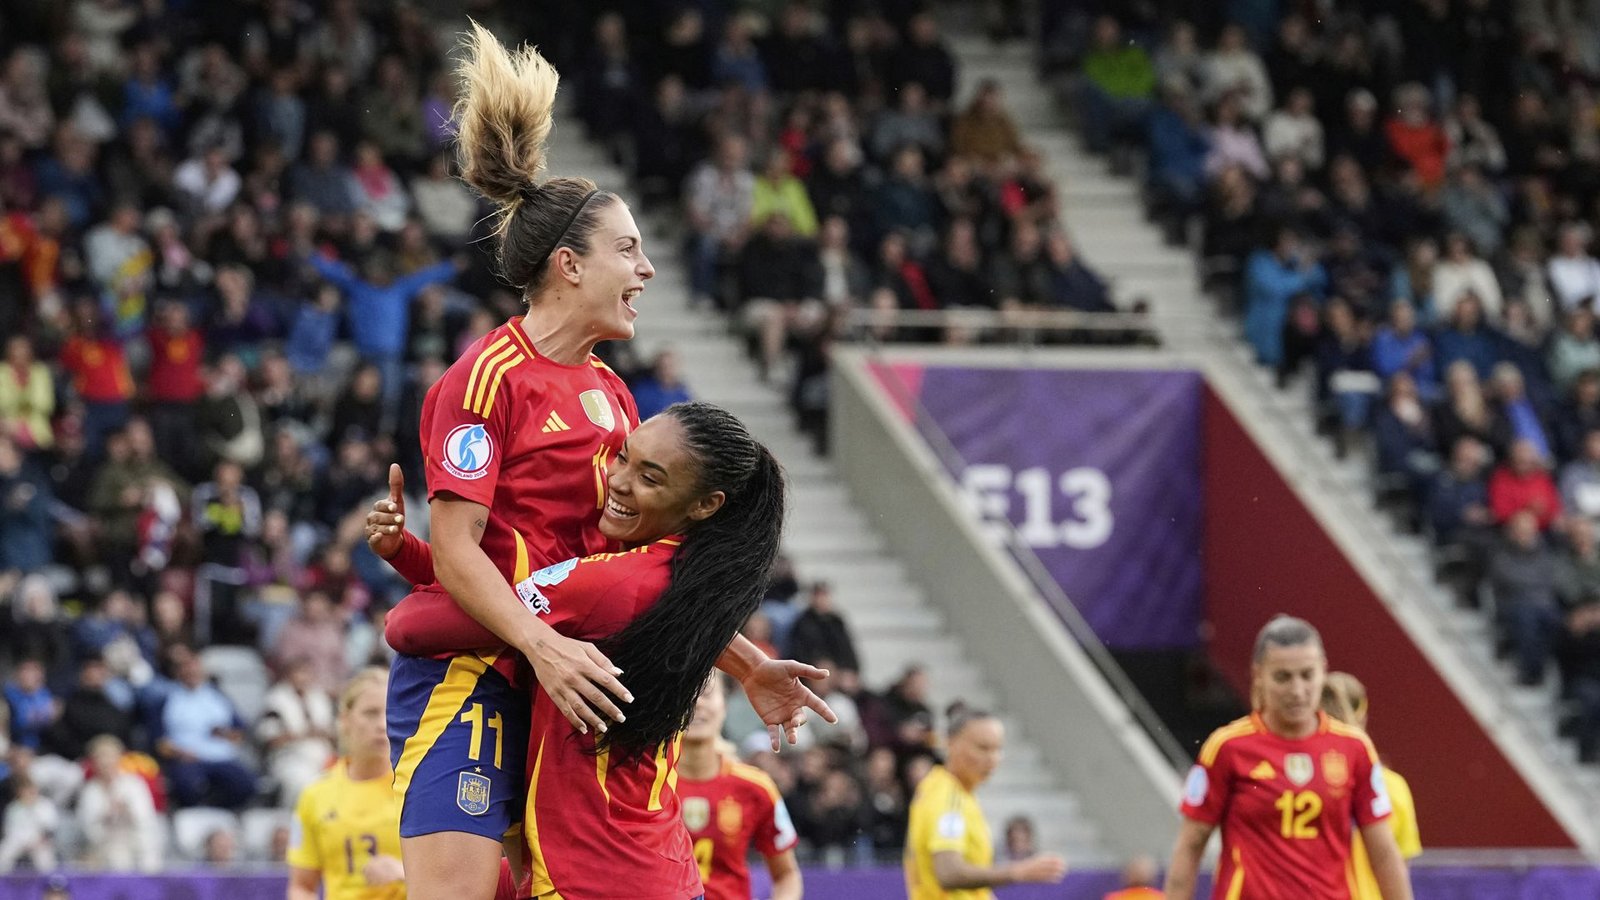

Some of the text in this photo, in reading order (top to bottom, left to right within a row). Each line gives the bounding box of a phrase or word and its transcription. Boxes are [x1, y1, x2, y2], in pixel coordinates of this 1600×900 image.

[443, 461, 473, 478] SWITZERLAND
[959, 463, 1114, 549] E13
[461, 702, 503, 770] 11
[1274, 789, 1323, 839] 12
